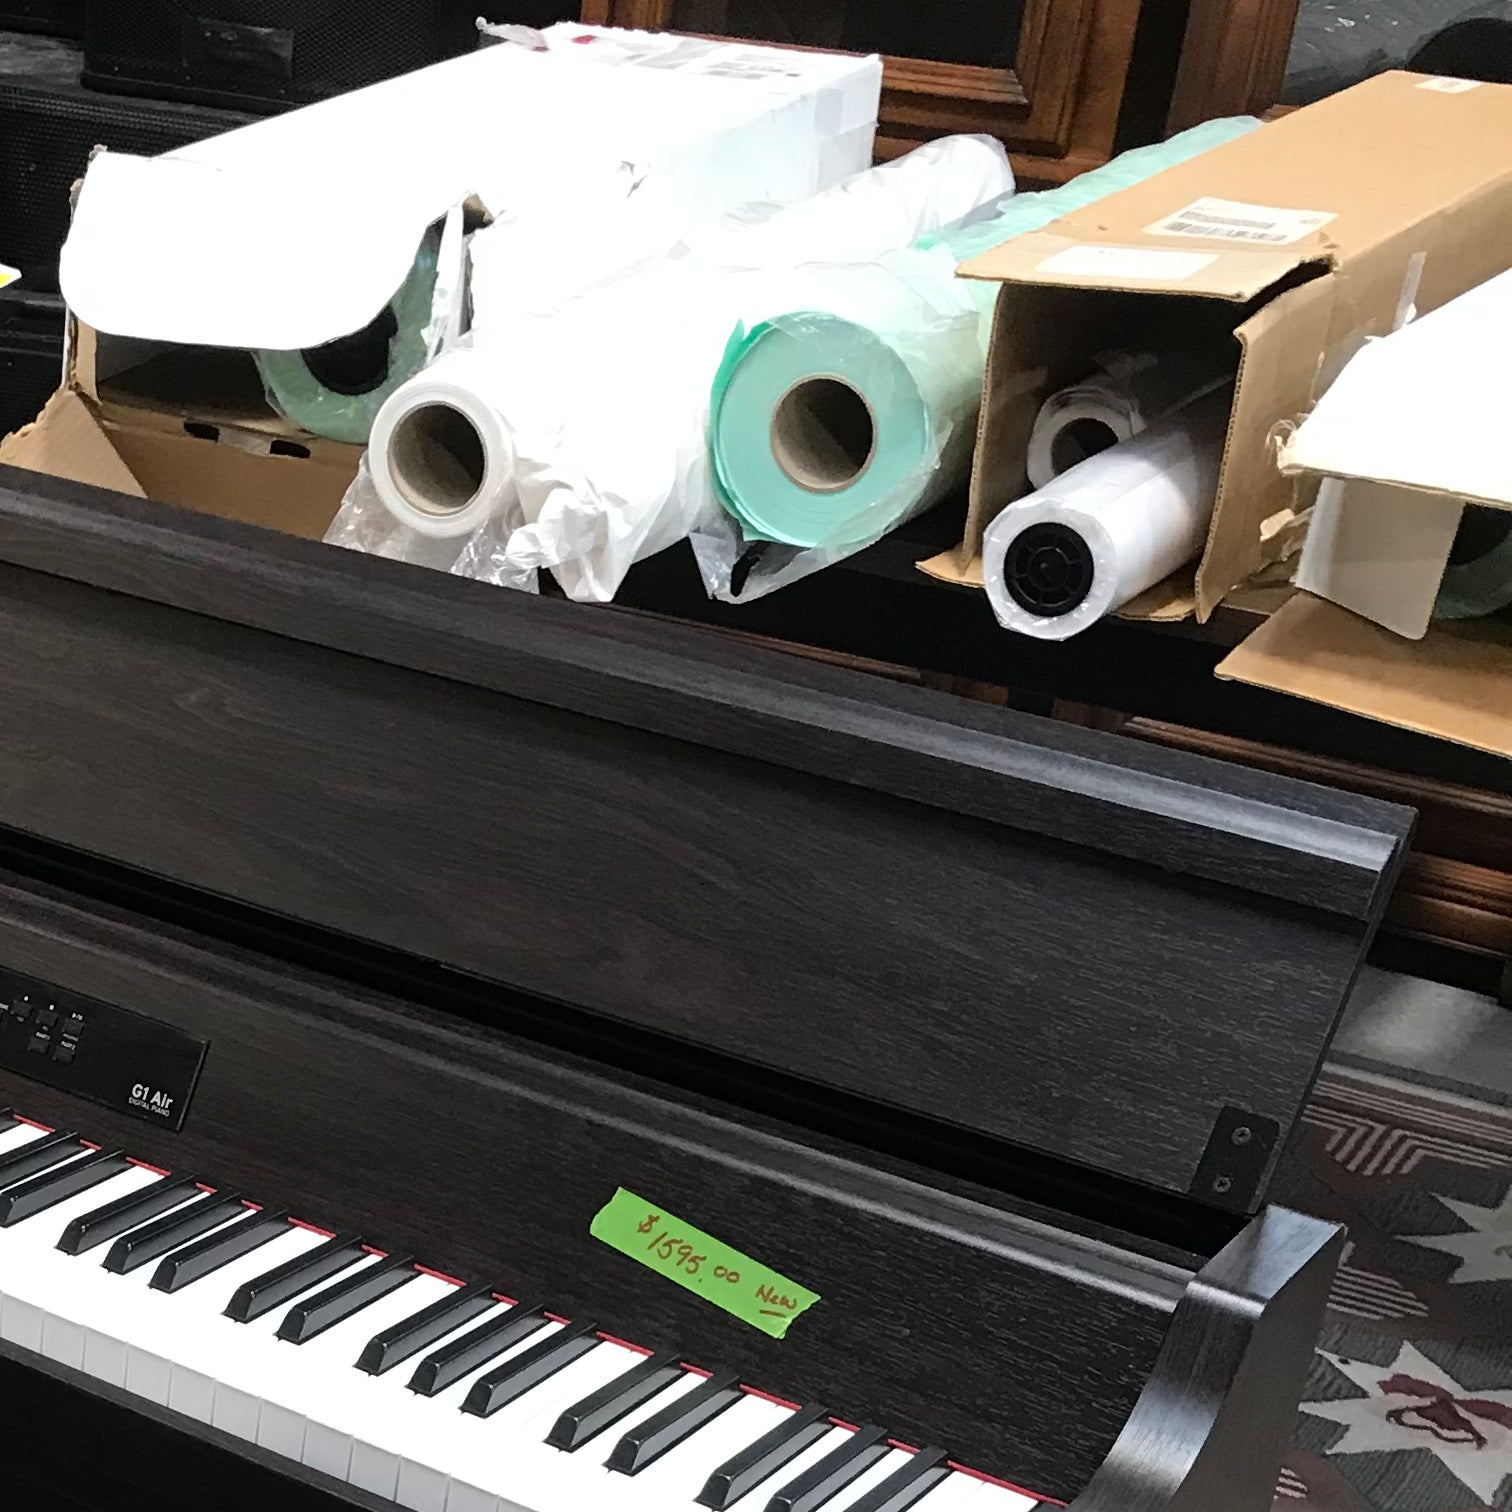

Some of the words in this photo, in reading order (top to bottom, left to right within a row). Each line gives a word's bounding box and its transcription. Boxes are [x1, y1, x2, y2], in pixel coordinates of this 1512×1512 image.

[131, 1083, 150, 1101] G1
[149, 1090, 174, 1109] Air
[754, 1284, 798, 1311] New
